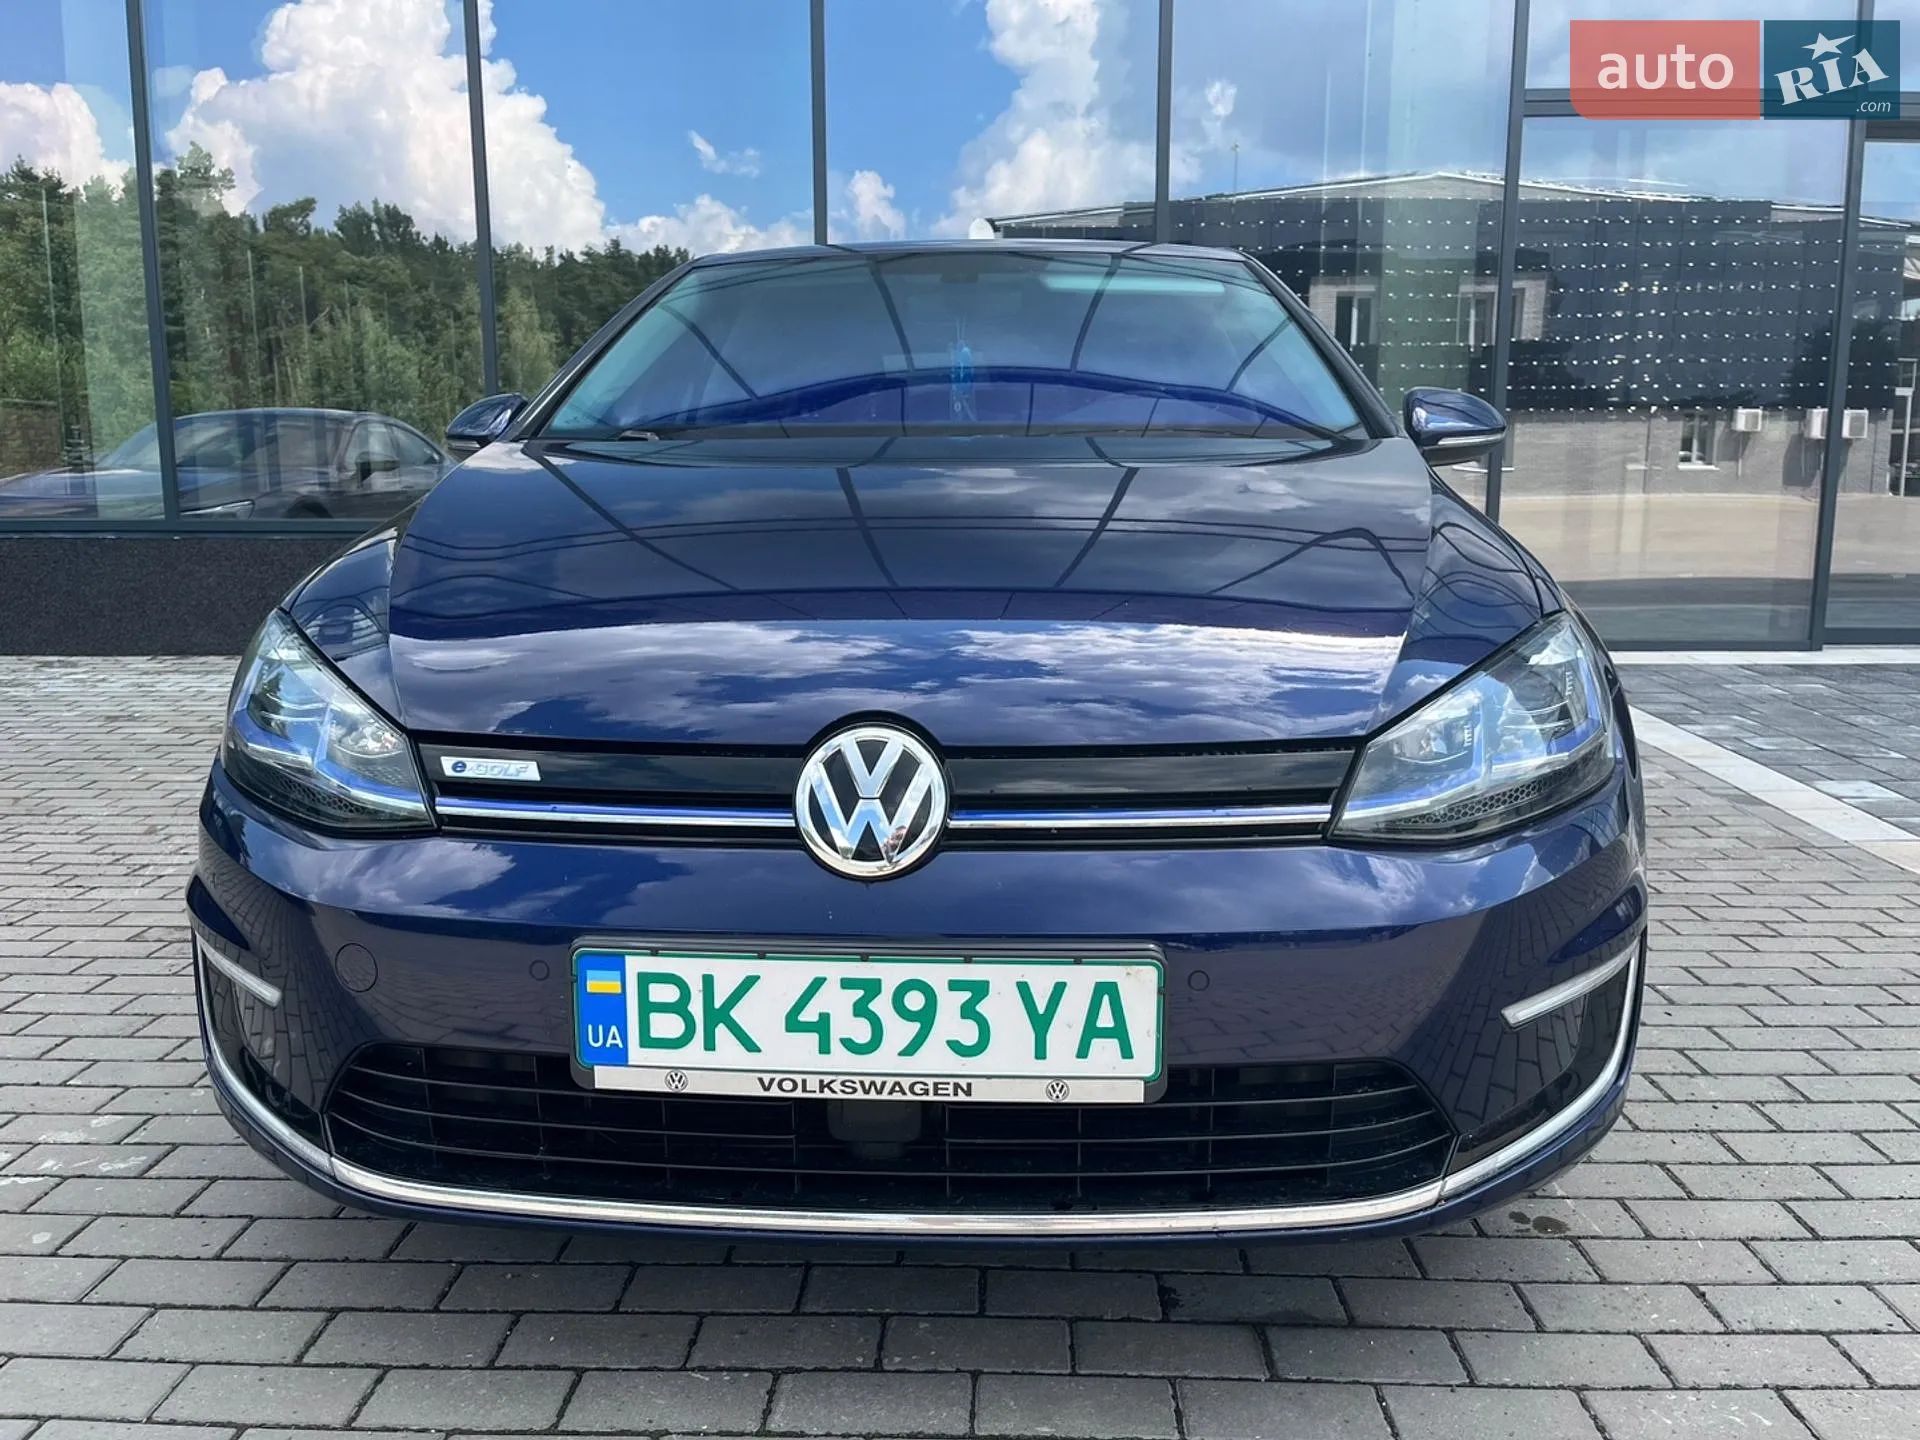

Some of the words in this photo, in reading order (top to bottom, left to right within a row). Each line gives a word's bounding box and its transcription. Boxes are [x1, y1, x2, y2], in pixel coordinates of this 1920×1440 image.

[637, 971, 762, 1054] BK
[783, 976, 991, 1056] 4393
[1016, 981, 1135, 1060] YA
[587, 1024, 624, 1049] UA
[757, 1076, 973, 1098] VOLKSWAGEN
